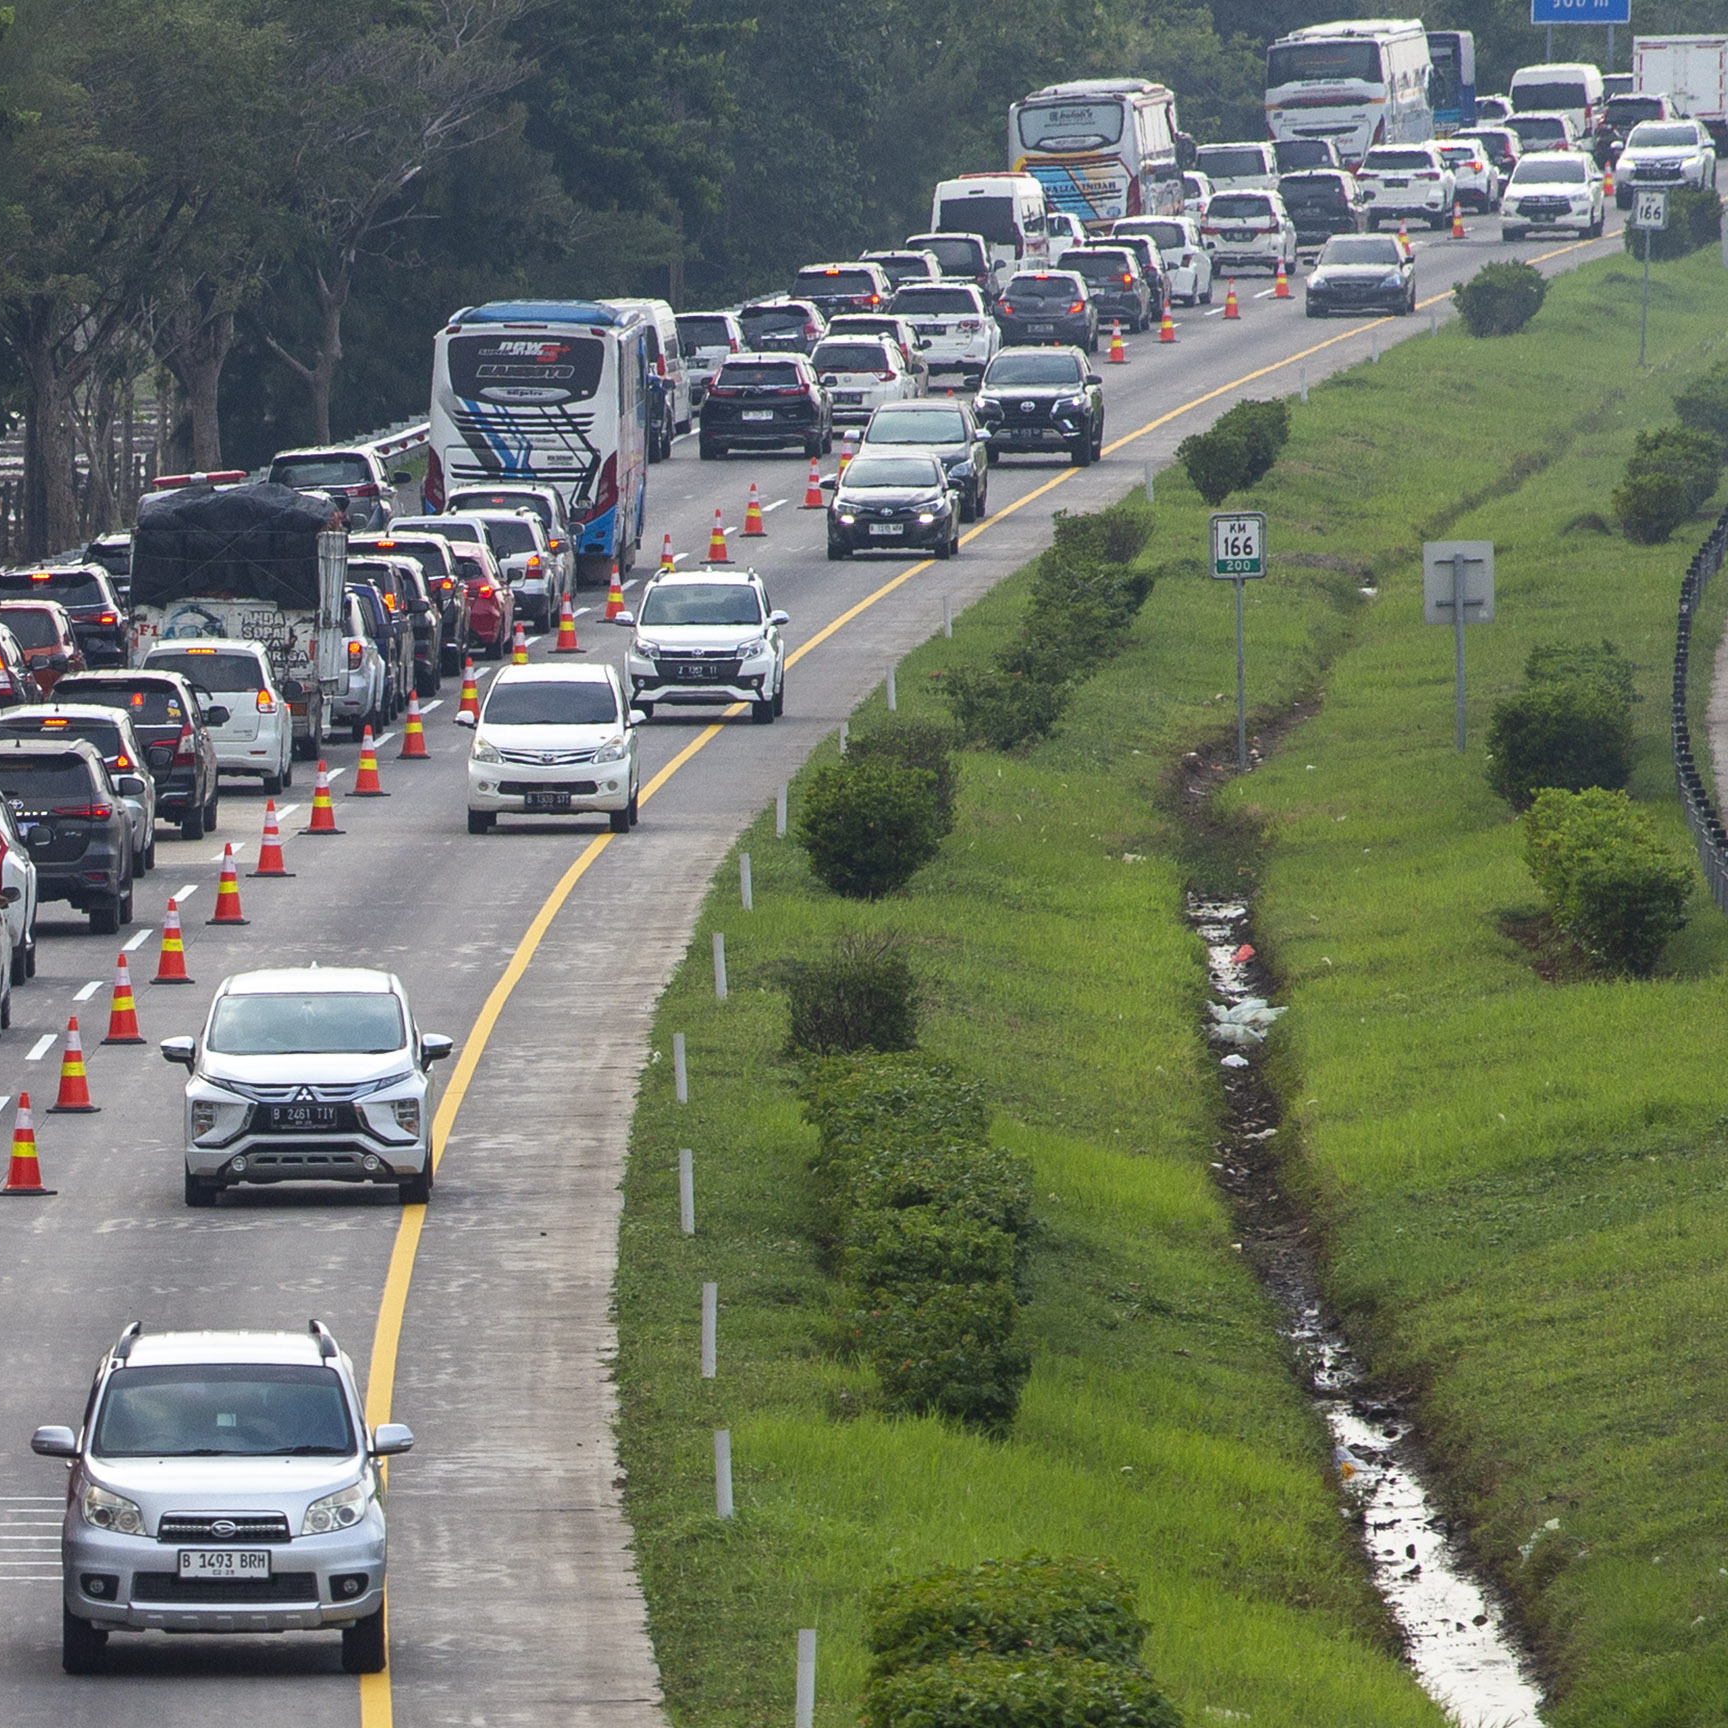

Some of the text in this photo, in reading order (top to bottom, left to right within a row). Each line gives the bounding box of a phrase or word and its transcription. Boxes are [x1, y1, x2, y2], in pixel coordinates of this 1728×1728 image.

[1640, 204, 1661, 220] 166
[1229, 523, 1247, 534] KM
[1224, 536, 1253, 557] 166
[1226, 560, 1252, 571] 200
[243, 610, 286, 626] ANDA
[274, 1108, 280, 1120] B
[317, 1107, 334, 1120] TIY
[182, 1553, 266, 1569] B 1493 BRH
